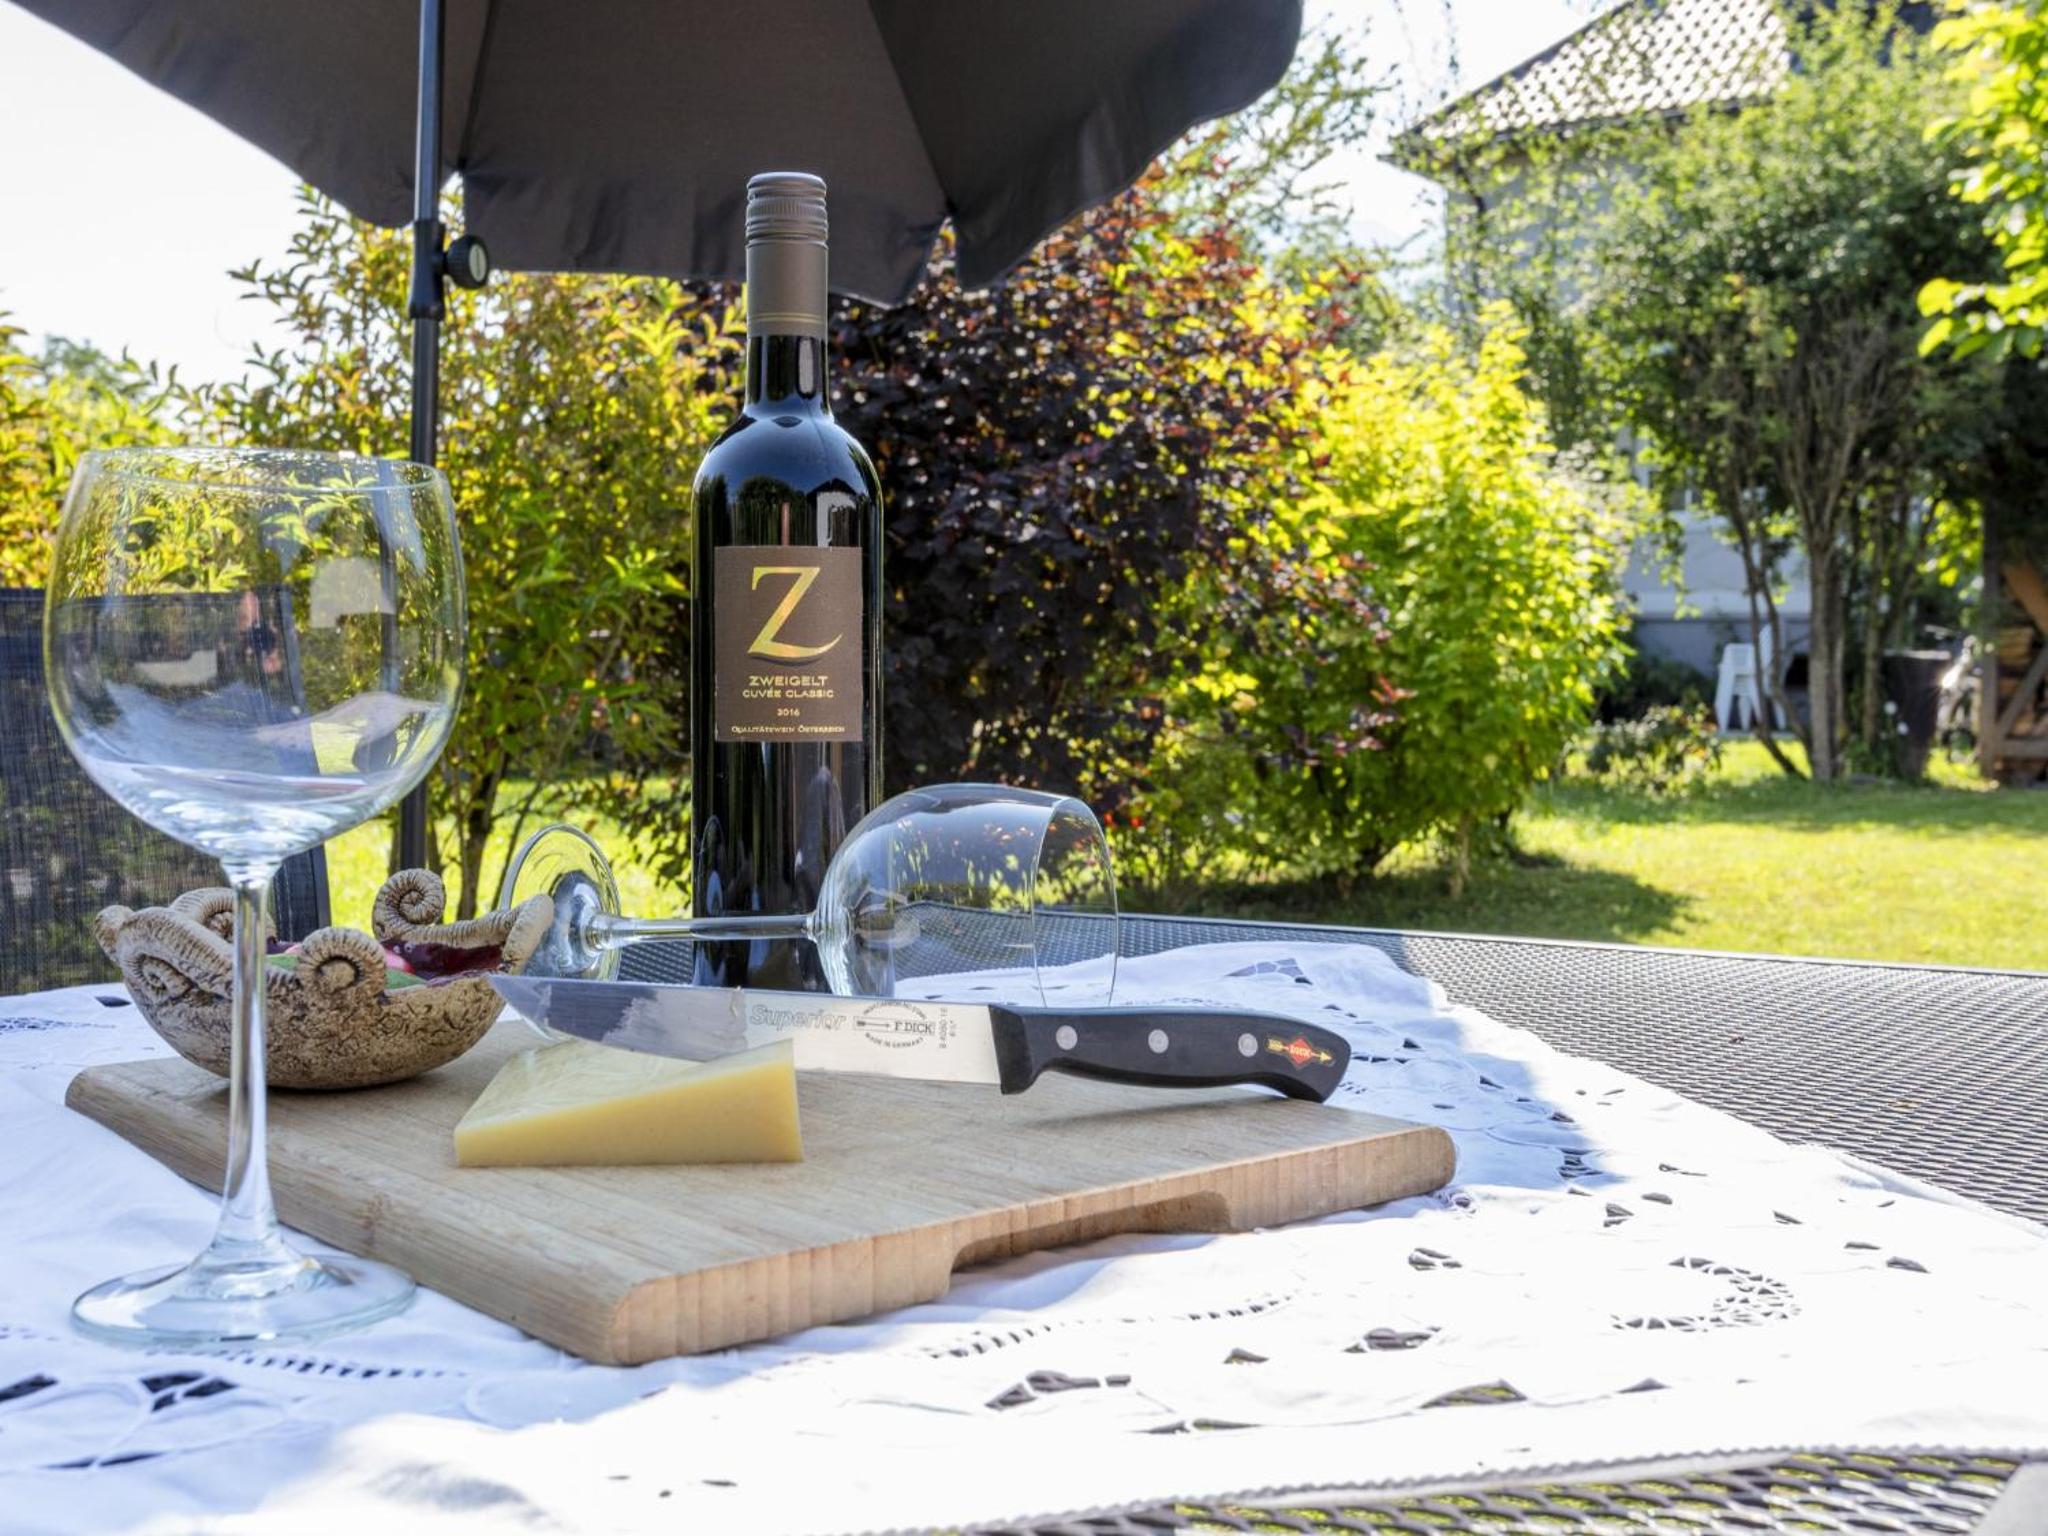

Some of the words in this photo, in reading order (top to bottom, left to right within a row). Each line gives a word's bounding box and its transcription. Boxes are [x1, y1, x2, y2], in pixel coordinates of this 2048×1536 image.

[747, 566, 843, 658] Z
[749, 676, 828, 686] ZWEIGELT
[742, 687, 782, 698] CUVÉE
[785, 689, 834, 698] CLASSIC
[777, 708, 800, 716] 2016
[750, 1004, 846, 1031] Superior
